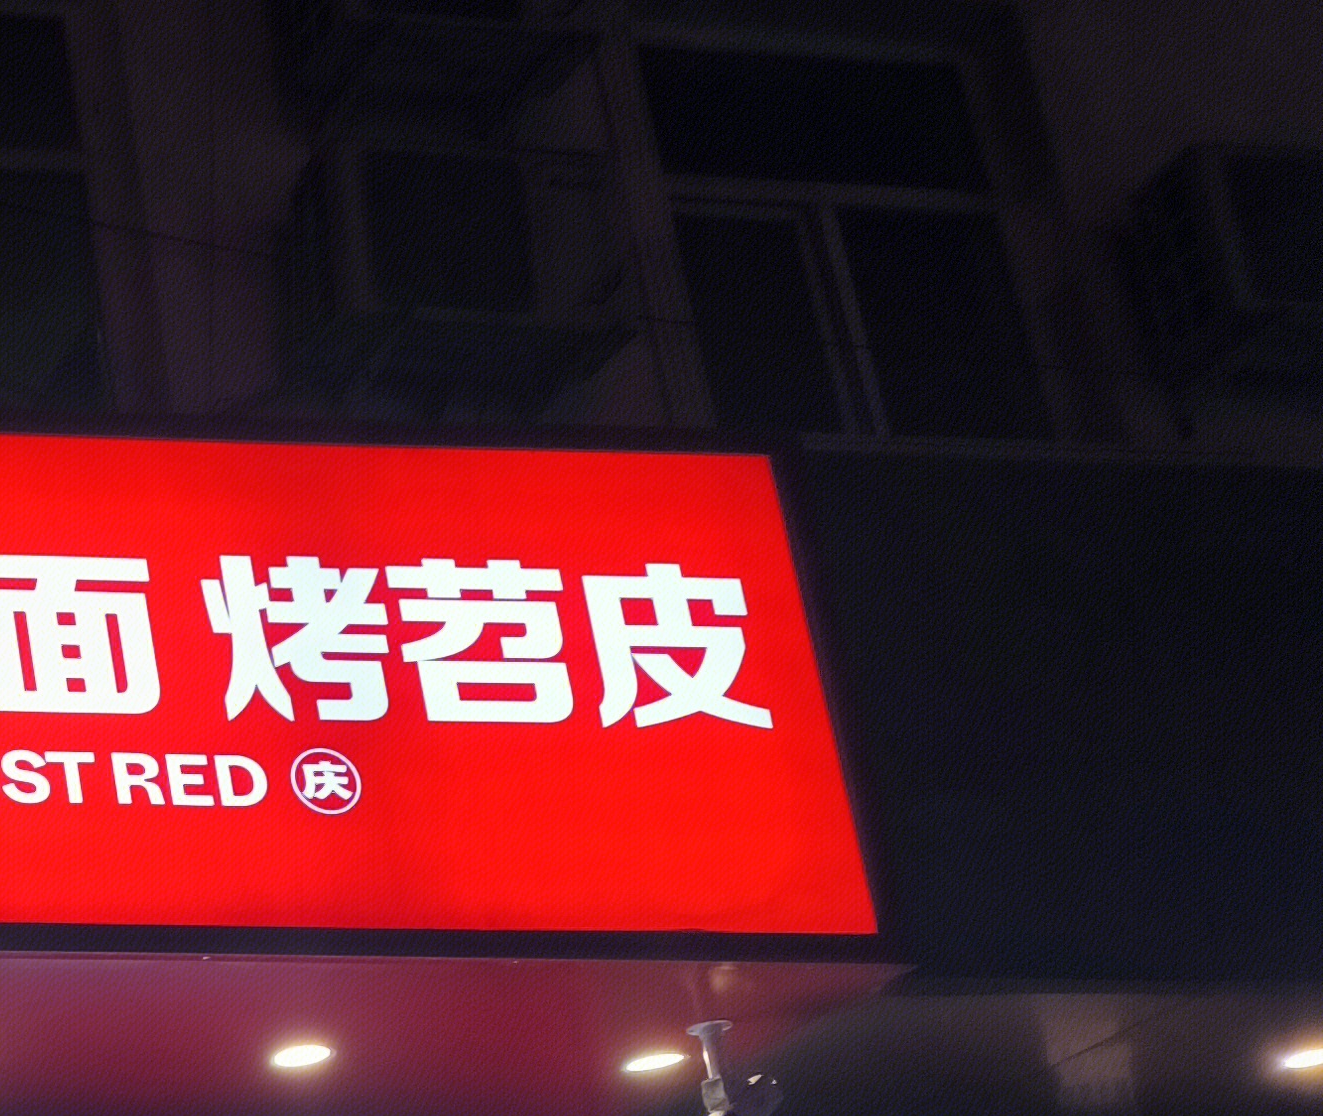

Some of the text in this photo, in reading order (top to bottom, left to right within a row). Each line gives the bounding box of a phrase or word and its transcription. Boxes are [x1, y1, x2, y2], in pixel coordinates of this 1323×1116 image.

[201, 556, 773, 728] 烤苕皮
[111, 753, 267, 806] RED
[299, 757, 355, 804] 庆
